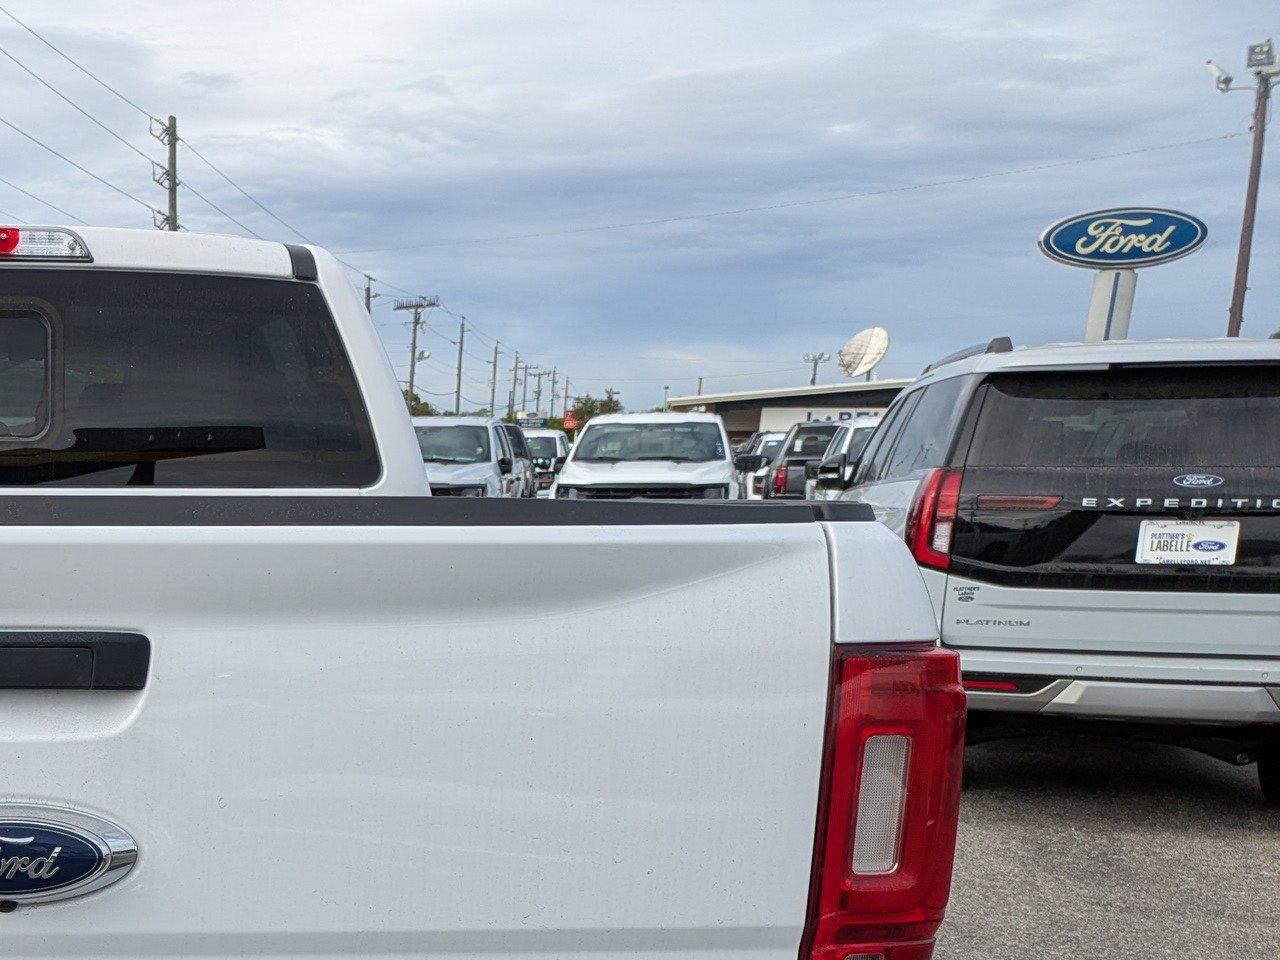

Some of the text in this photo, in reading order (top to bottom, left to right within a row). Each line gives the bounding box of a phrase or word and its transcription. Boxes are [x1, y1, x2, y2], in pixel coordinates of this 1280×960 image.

[1075, 218, 1177, 255] Ford
[1183, 475, 1214, 485] Ford
[1150, 532, 1185, 540] PLATTNER'S
[1150, 540, 1192, 552] LABELLE
[1198, 541, 1220, 550] Ford
[956, 619, 1031, 627] PLATINUM
